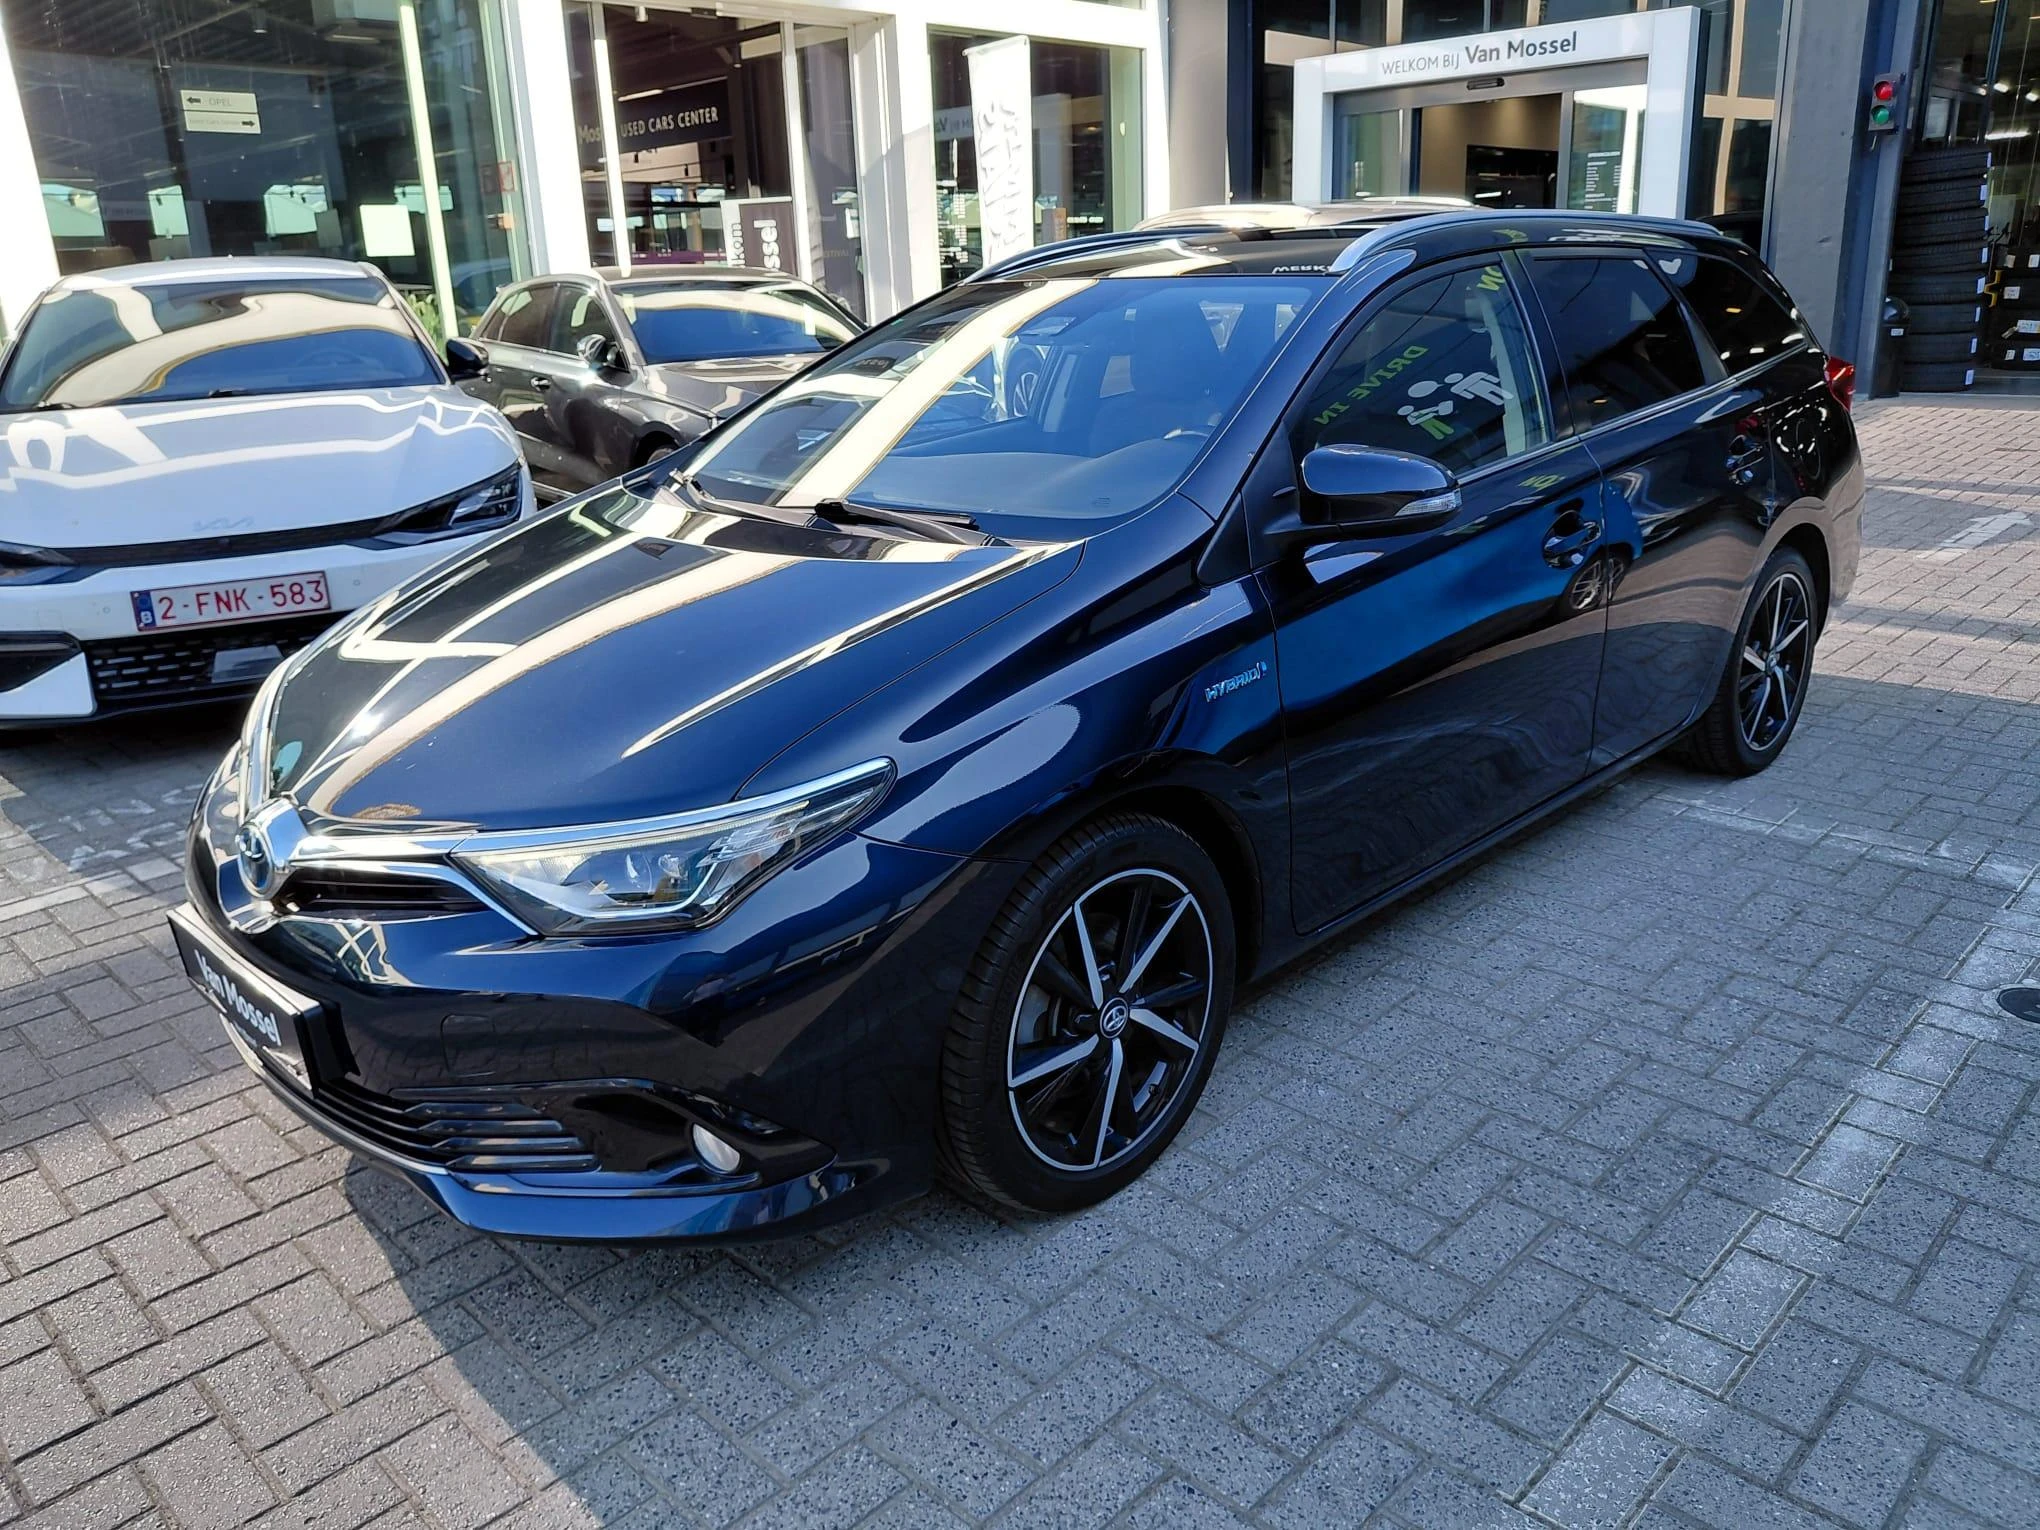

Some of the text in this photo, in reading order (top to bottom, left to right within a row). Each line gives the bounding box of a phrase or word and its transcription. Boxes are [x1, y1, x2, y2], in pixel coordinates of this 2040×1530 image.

[1381, 31, 1577, 75] WELKOM BIJ Van Mossel
[578, 106, 719, 144] Mos USED CARS CENTER
[731, 222, 746, 266] lkom
[753, 219, 781, 270] ssel
[1204, 662, 1261, 703] HYBRID
[194, 949, 226, 999] Van
[222, 975, 282, 1047] Mossel
